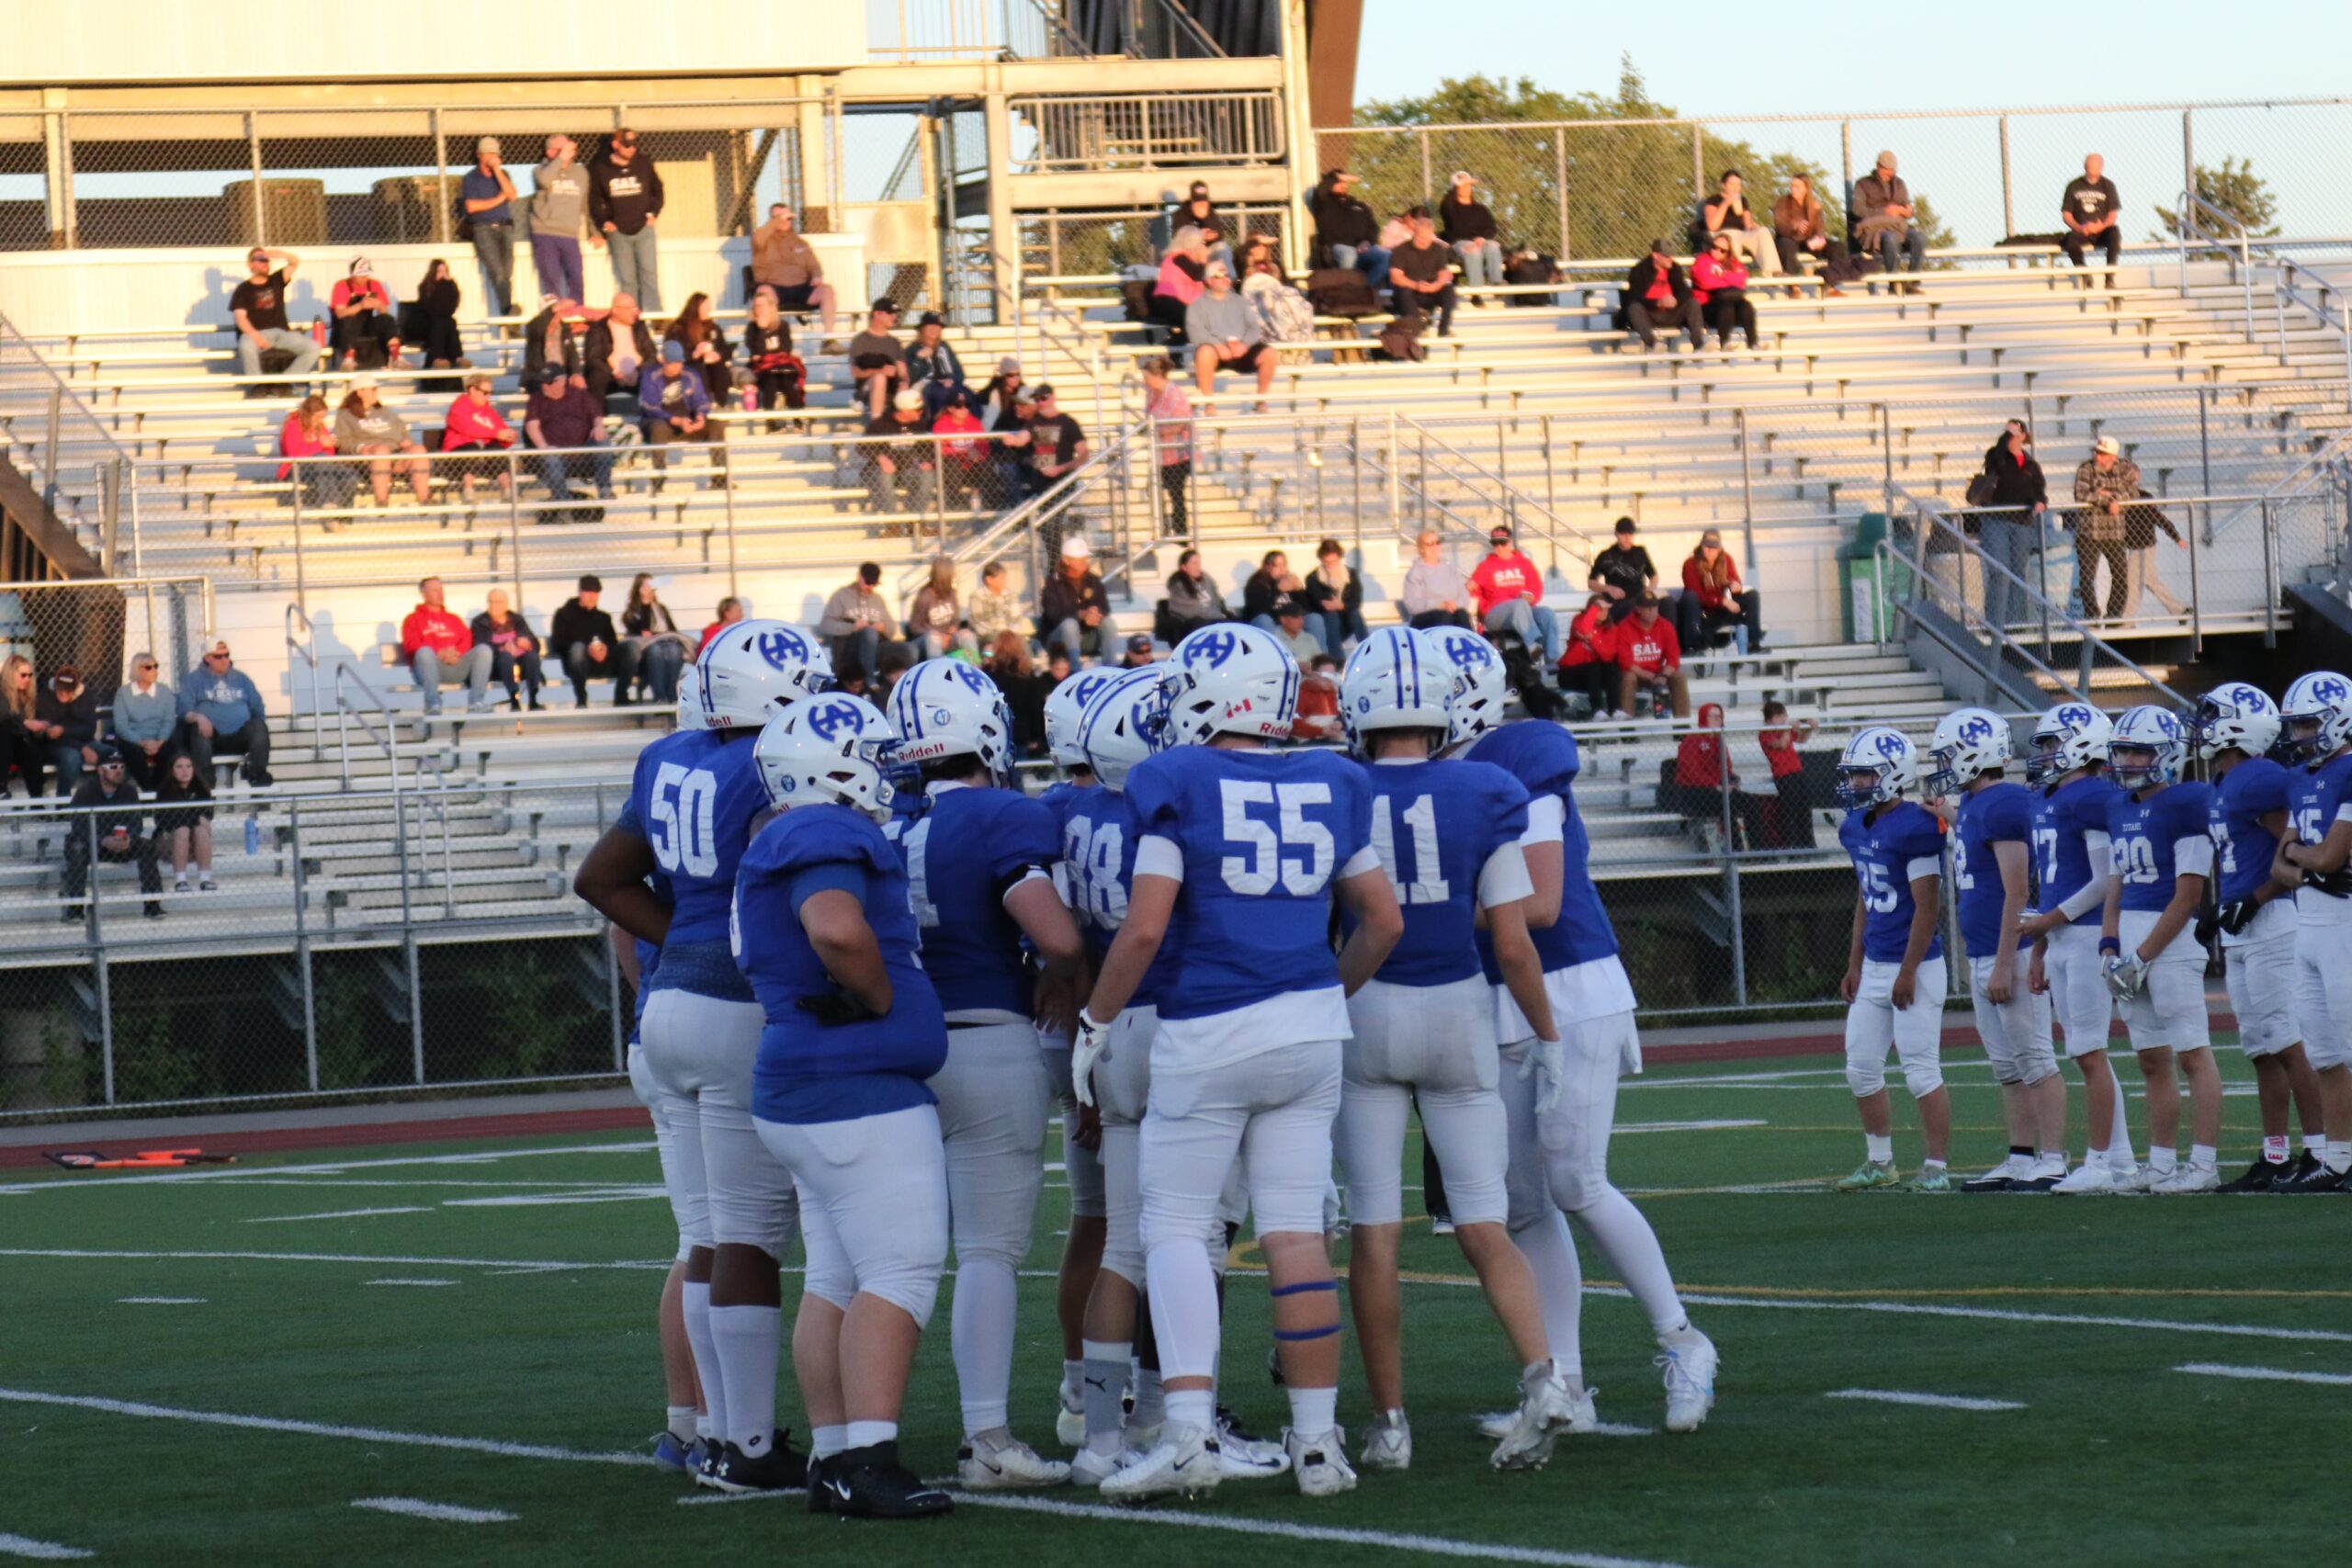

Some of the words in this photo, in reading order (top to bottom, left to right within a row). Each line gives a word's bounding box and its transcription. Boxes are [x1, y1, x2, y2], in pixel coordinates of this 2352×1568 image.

[1493, 568, 1525, 581] SAL
[1633, 642, 1662, 657] SAL
[898, 742, 944, 762] Riddell
[650, 761, 718, 878] 50
[1219, 779, 1335, 897] 55
[2114, 836, 2160, 884] 20
